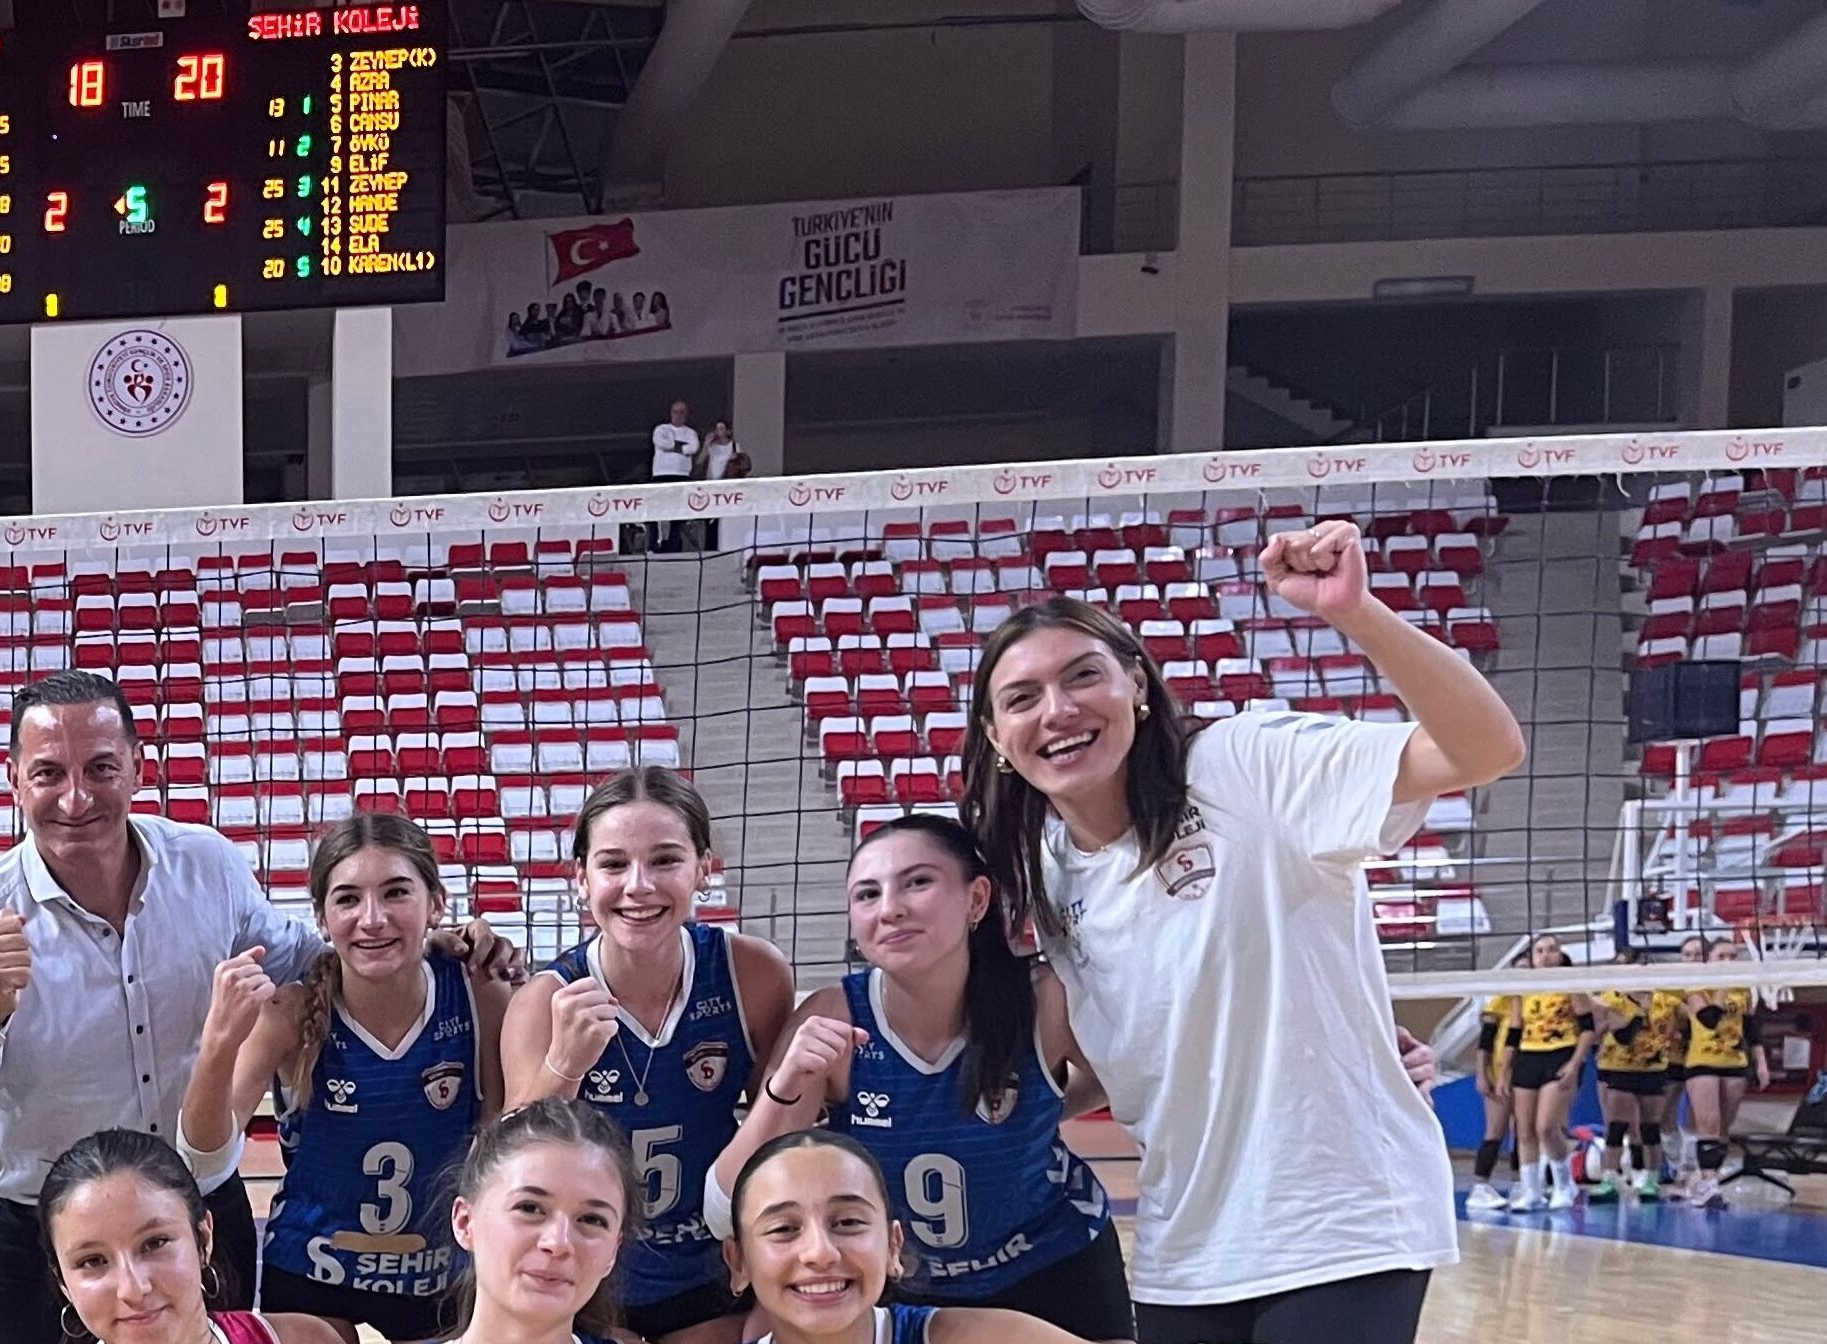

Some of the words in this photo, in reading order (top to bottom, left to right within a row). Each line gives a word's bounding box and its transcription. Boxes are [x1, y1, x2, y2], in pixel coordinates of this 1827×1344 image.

[330, 54, 342, 72] 3
[69, 61, 104, 107] 18
[174, 54, 223, 101] 20
[330, 74, 341, 92] 4
[350, 71, 390, 92] AZRA
[122, 101, 151, 118] TIME
[269, 98, 285, 117] 13
[303, 95, 310, 114] 1
[330, 94, 341, 113] 5
[350, 90, 399, 112] PINAR
[330, 114, 341, 133] 6
[350, 112, 399, 132] CANSU
[297, 135, 310, 156] 2
[331, 135, 341, 153] 7
[330, 156, 342, 173] 9
[263, 179, 284, 199] 25
[297, 176, 310, 197] 3
[321, 176, 339, 195] 11
[350, 172, 408, 193] ZEYNEP
[45, 192, 68, 231] 2
[126, 186, 147, 223] 5
[204, 183, 227, 223] 2
[321, 197, 341, 215] 12
[349, 193, 398, 213] HANDE
[119, 219, 156, 235] PERIOD
[263, 219, 284, 239] 25
[297, 217, 310, 236] 4
[321, 216, 341, 235] 13
[349, 214, 389, 233] SUDE
[321, 236, 341, 255] 14
[349, 234, 379, 253] ELA
[263, 259, 285, 278] 20
[297, 256, 310, 277] 5
[321, 256, 341, 275] 10
[1546, 449, 1575, 465] TVF
[1752, 443, 1783, 456] TVF
[1125, 468, 1156, 483] TVF
[1336, 458, 1366, 472] TVF
[917, 480, 947, 494] TVF
[714, 492, 743, 506] TVF
[317, 513, 347, 526] TVF
[514, 503, 543, 517] TVF
[124, 522, 153, 536] TVF
[632, 1124, 683, 1220] 5
[359, 1141, 414, 1236] 3
[904, 1153, 969, 1249] 9
